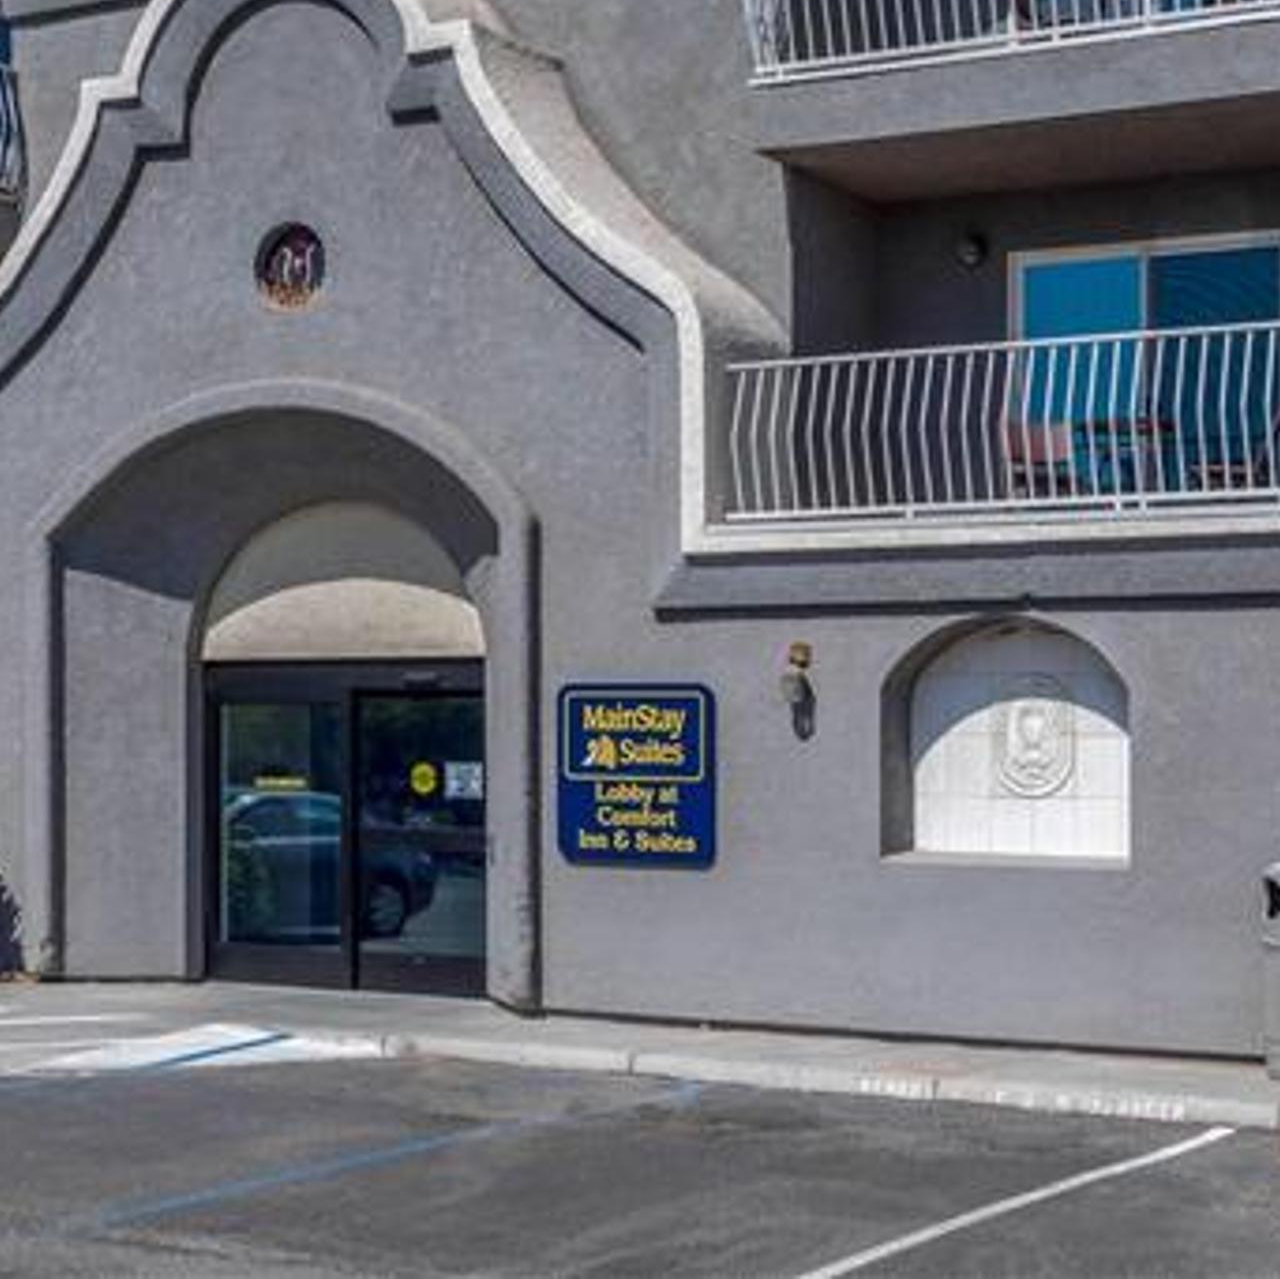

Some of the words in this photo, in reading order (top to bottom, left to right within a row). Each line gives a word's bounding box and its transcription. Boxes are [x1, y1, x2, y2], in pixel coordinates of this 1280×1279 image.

[582, 702, 686, 739] MainStay
[620, 738, 685, 765] Suites
[595, 782, 655, 807] Lobby
[658, 786, 678, 804] at
[598, 805, 676, 827] Comfort
[579, 828, 608, 849] Inn
[614, 829, 629, 851] &
[635, 830, 697, 852] Suites
